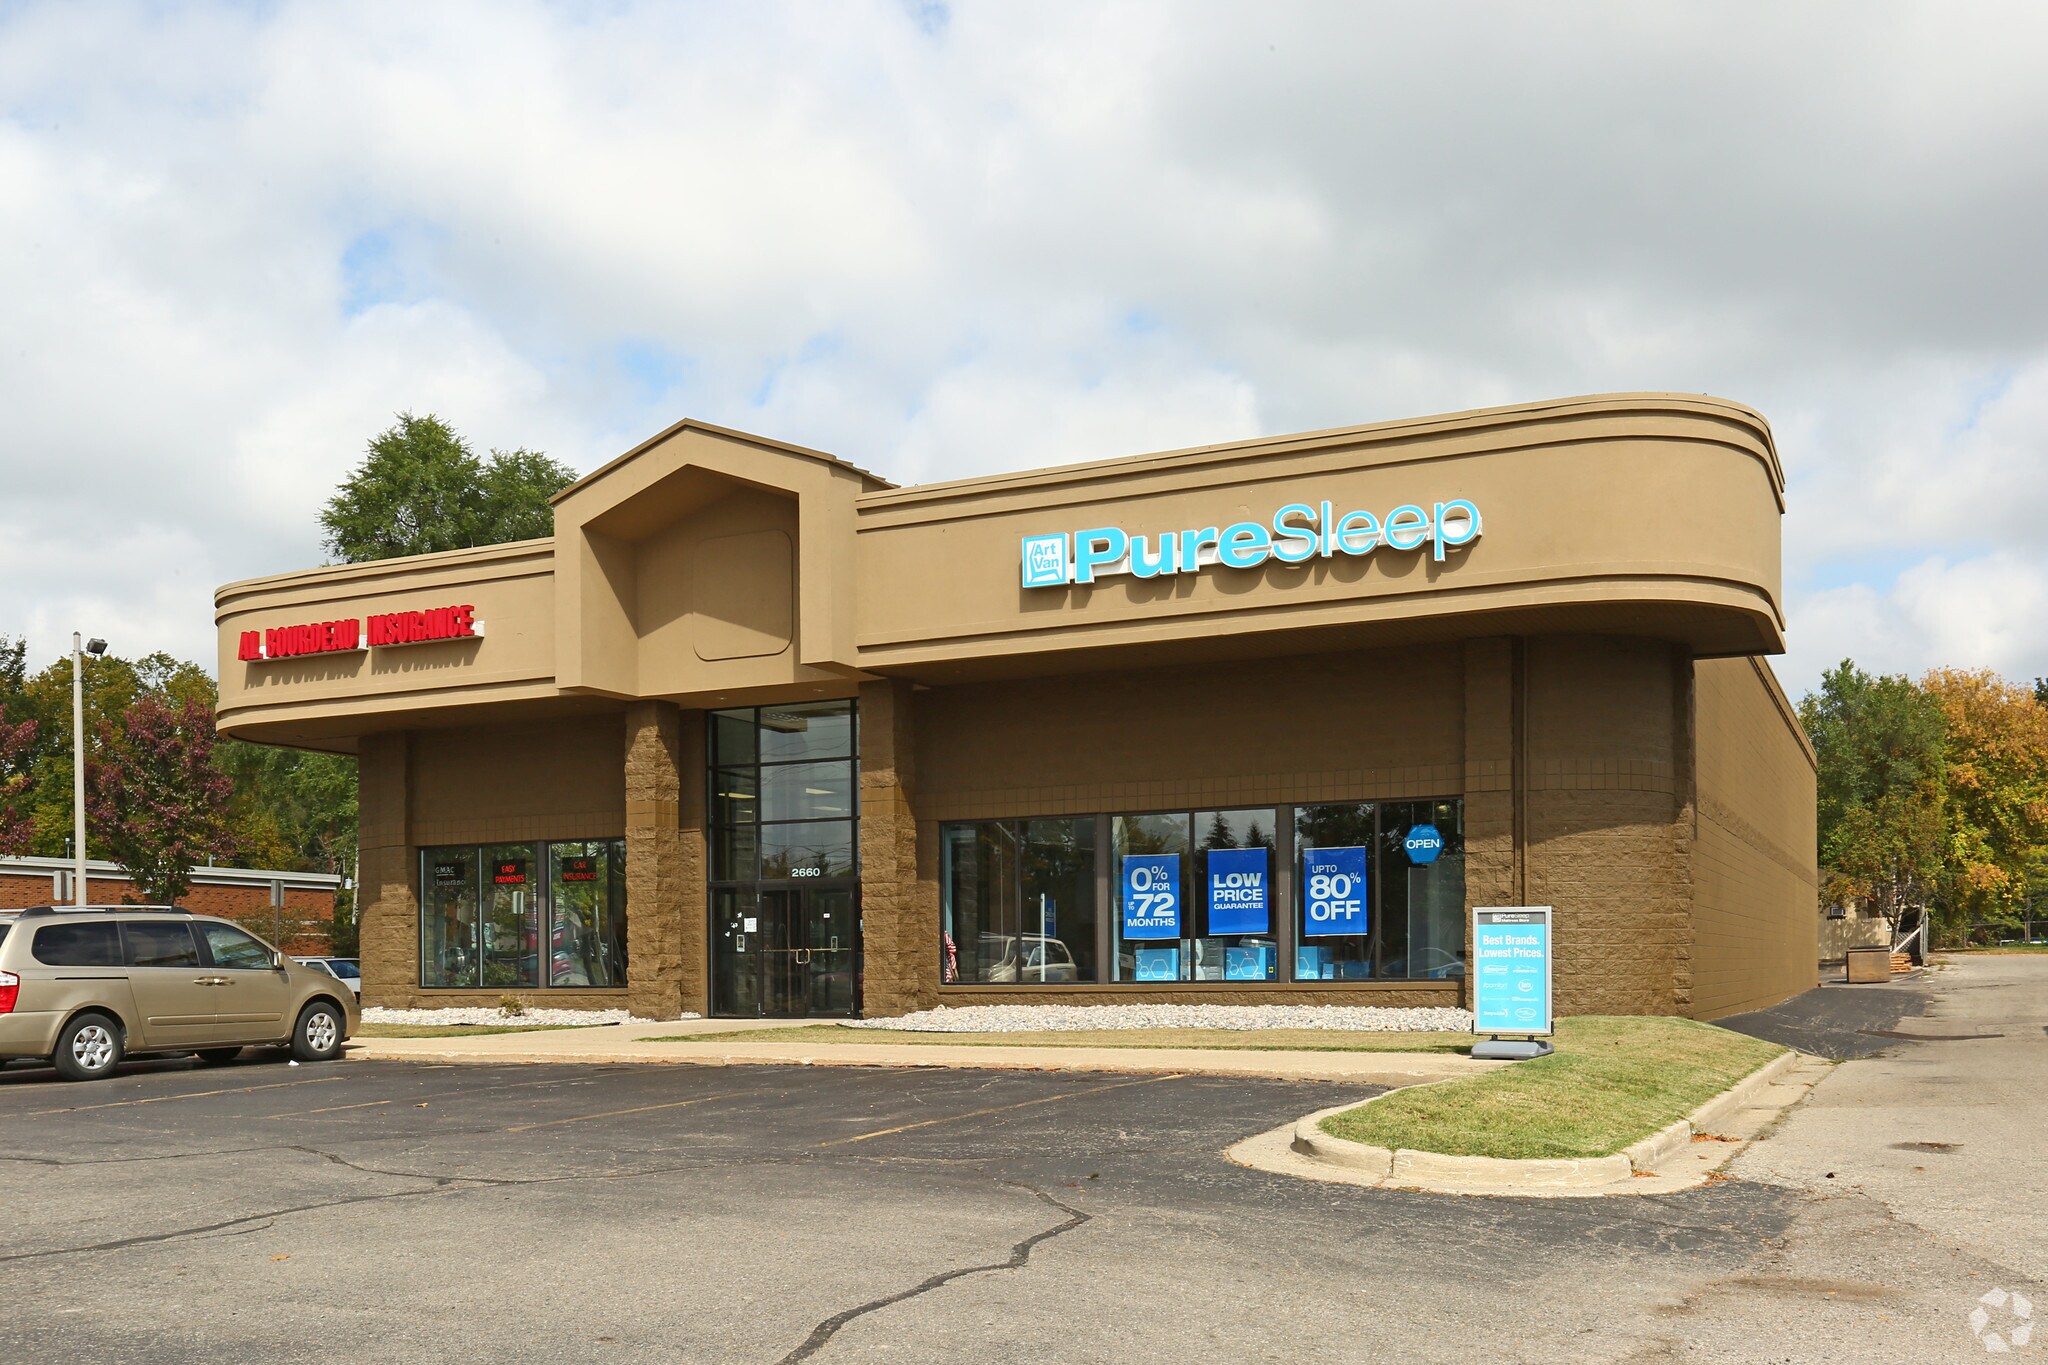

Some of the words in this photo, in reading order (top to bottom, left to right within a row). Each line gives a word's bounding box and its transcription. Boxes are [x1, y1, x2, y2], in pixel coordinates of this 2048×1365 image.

[1074, 498, 1482, 584] PureSleep
[1034, 543, 1056, 556] Art
[1034, 556, 1059, 570] Van
[266, 618, 360, 658] BOURDEAU
[367, 604, 475, 647] INSURANCE
[1406, 839, 1440, 849] OPEN
[435, 866, 455, 874] GMAC
[501, 864, 516, 873] EASY
[791, 867, 820, 877] 2660
[495, 874, 525, 883] PAYMENTS
[563, 872, 597, 880] INSURANCE
[1131, 865, 1168, 892] 0%
[1213, 872, 1262, 888] LOW
[1152, 882, 1170, 891] FOR
[1309, 871, 1361, 900] 80%
[1213, 888, 1263, 902] PRICE
[1132, 892, 1175, 917] 72
[1213, 902, 1264, 910] GUARANTEE
[1310, 899, 1361, 921] OFF
[1127, 917, 1176, 927] MONTHS
[1482, 934, 1504, 945] Best
[1505, 934, 1540, 945] Brands.
[1478, 947, 1512, 958] Lowest
[1513, 947, 1544, 958] Prices.
